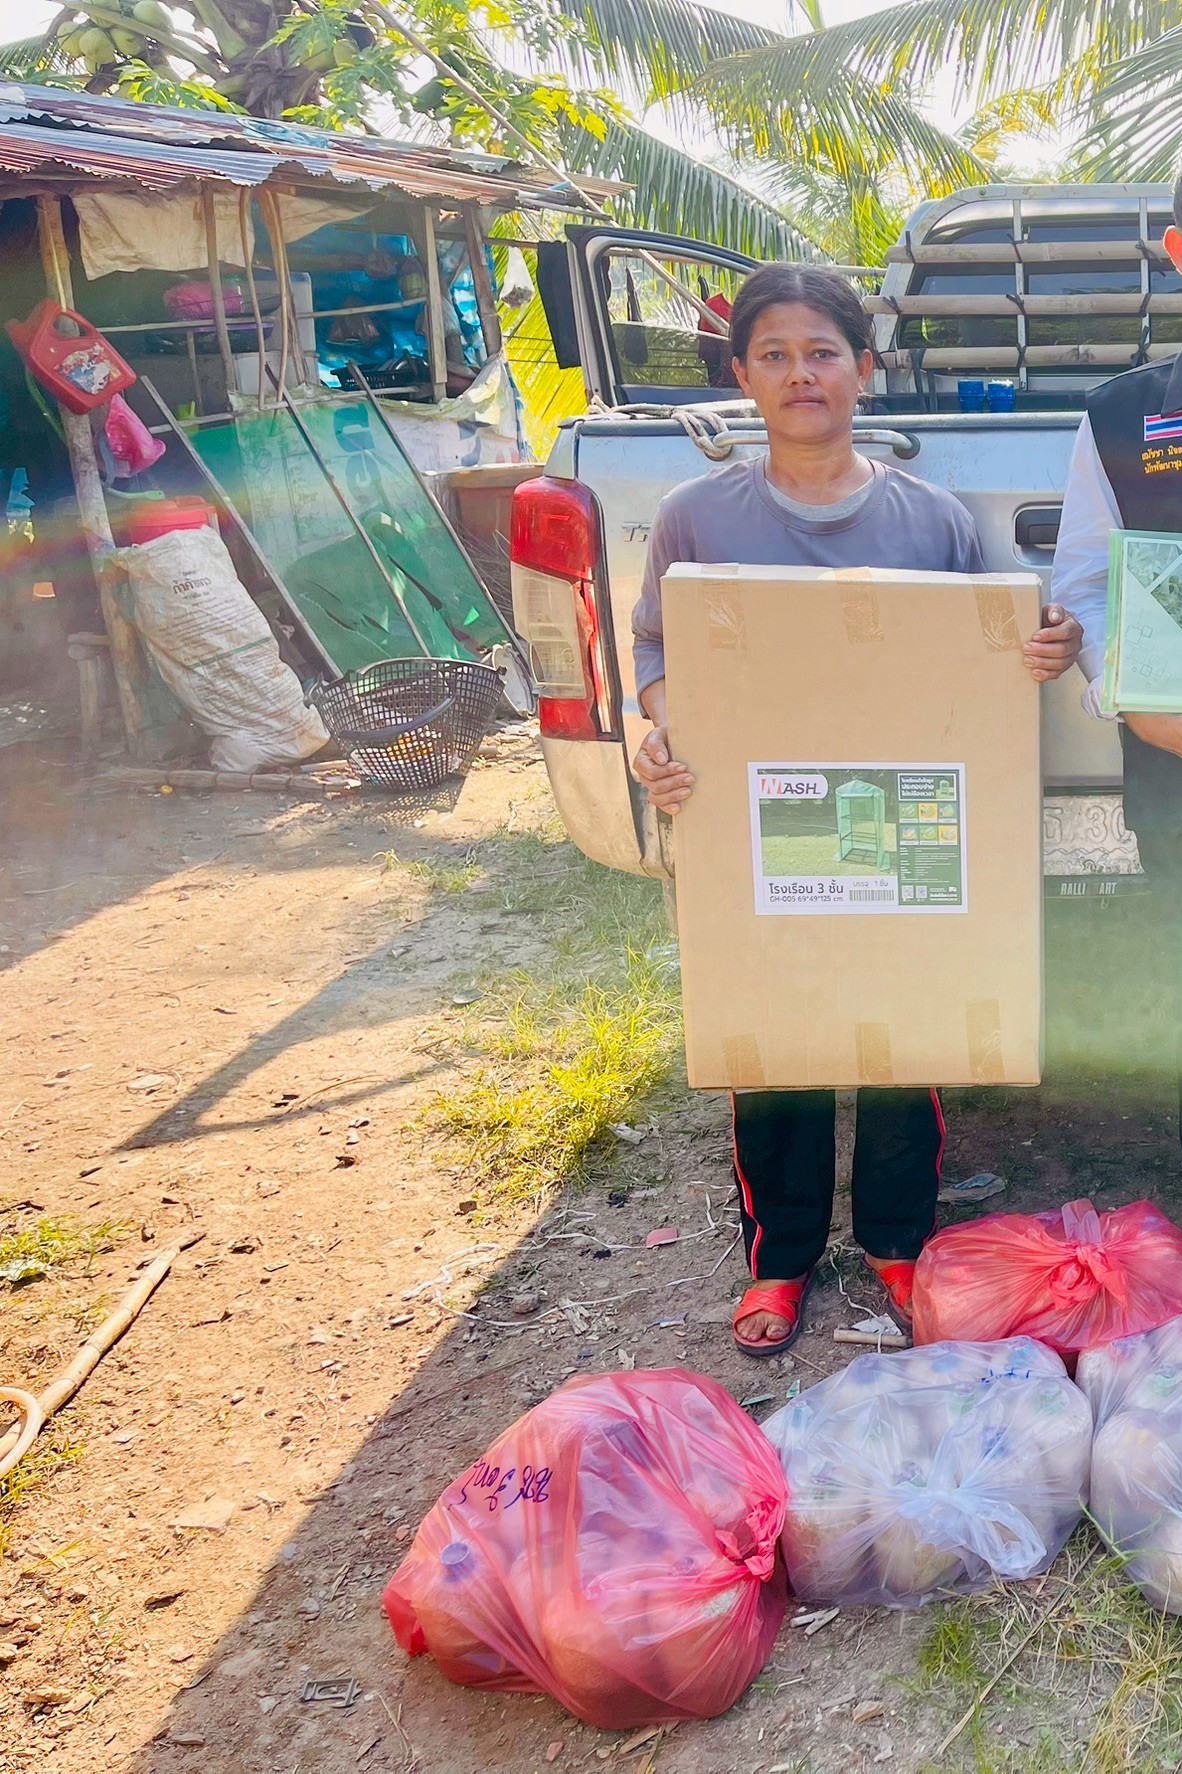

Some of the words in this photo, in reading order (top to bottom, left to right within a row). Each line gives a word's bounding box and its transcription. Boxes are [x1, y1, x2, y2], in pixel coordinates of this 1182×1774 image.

[769, 882, 813, 894] โรงเรือน
[817, 882, 825, 894] 3
[828, 879, 844, 894] ชั้น
[1060, 882, 1086, 896] RALLI
[1099, 882, 1117, 895] ART
